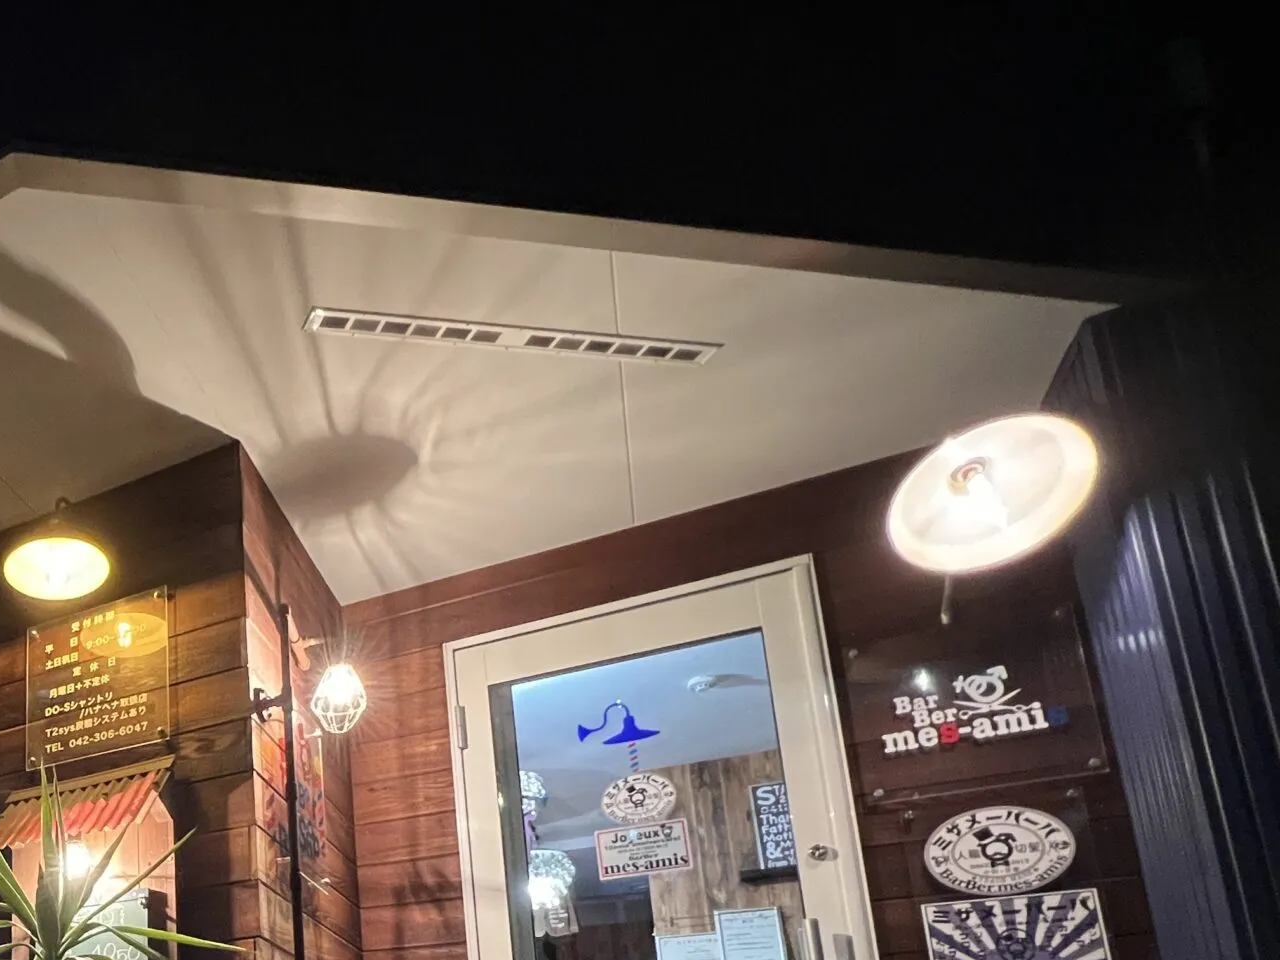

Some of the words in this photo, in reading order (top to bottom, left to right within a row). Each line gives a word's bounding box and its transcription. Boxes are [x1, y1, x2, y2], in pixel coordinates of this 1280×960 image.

[892, 694, 939, 715] Bar
[881, 701, 1069, 754] mes-amis
[911, 707, 958, 728] Ber
[45, 742, 64, 754] TEL
[604, 853, 689, 875] mes-amis
